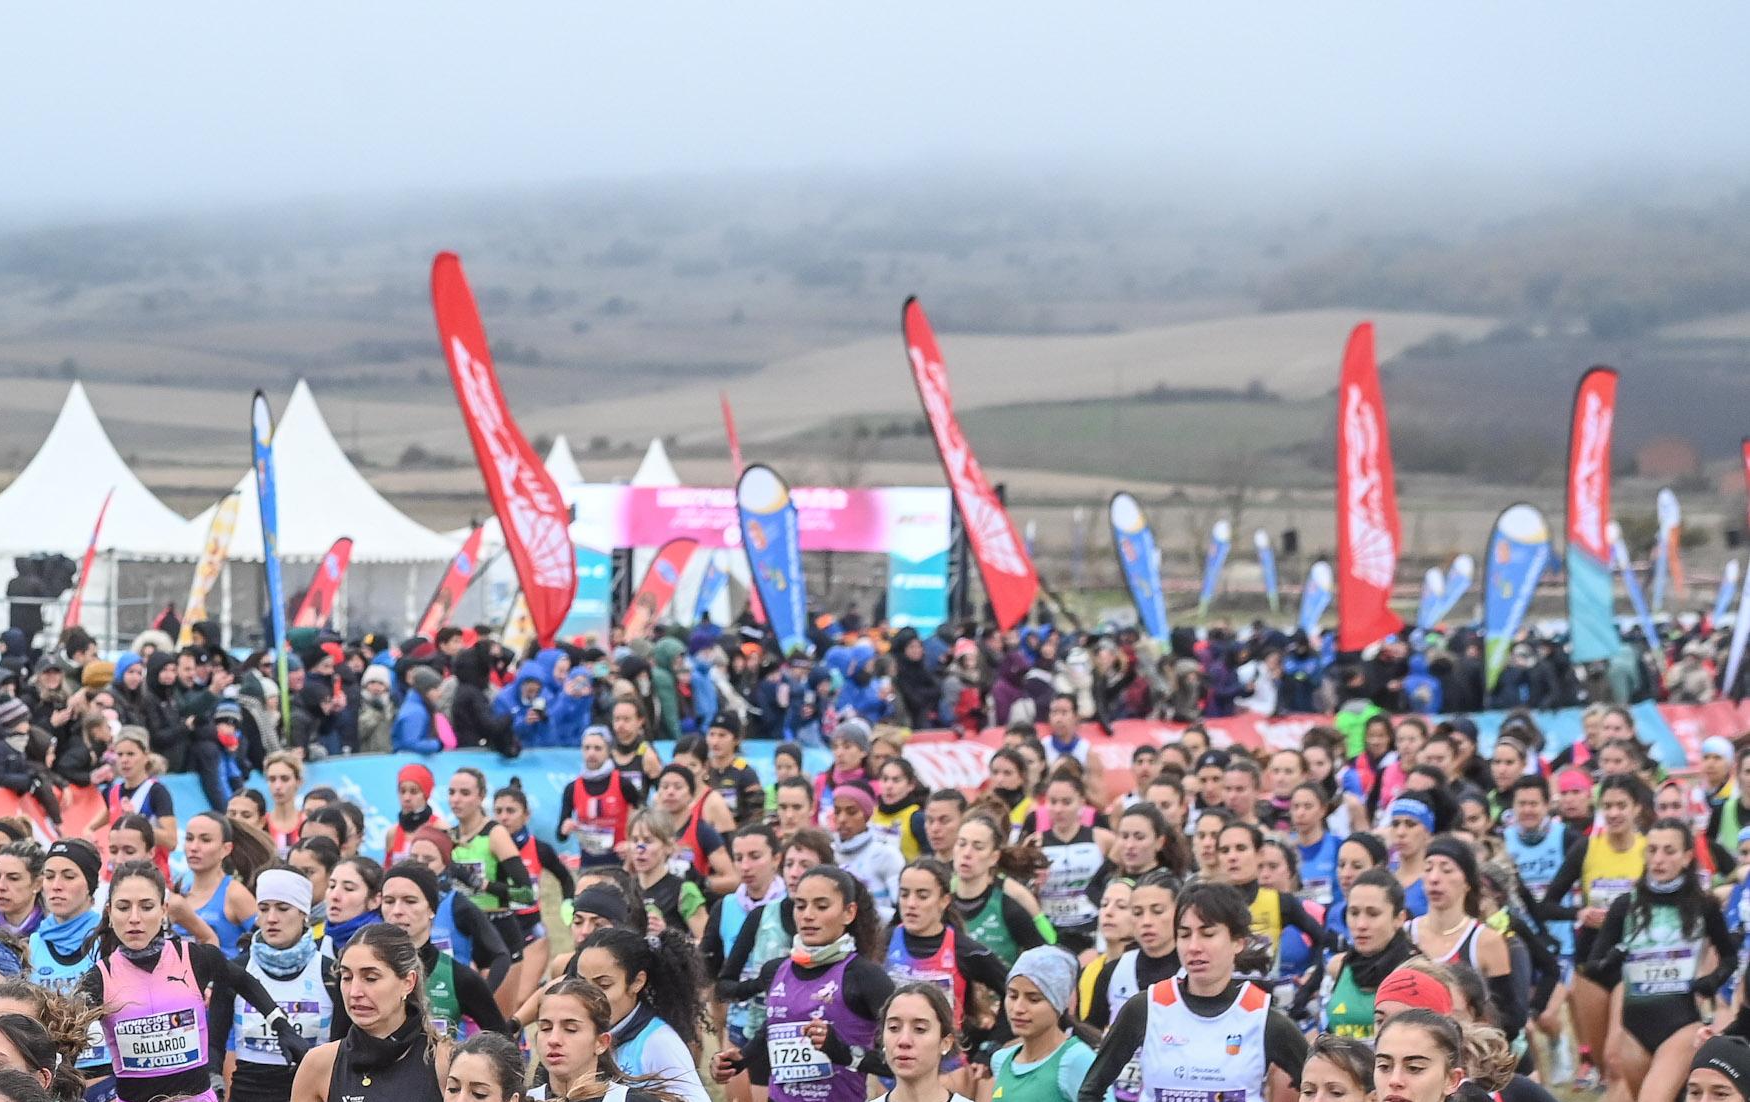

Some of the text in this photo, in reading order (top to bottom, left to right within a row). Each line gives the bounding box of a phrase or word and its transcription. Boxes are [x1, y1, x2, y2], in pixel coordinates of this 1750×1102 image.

[117, 1022, 171, 1034] BURGOS
[133, 1036, 187, 1055] GALLARDO
[774, 1048, 812, 1065] 1726
